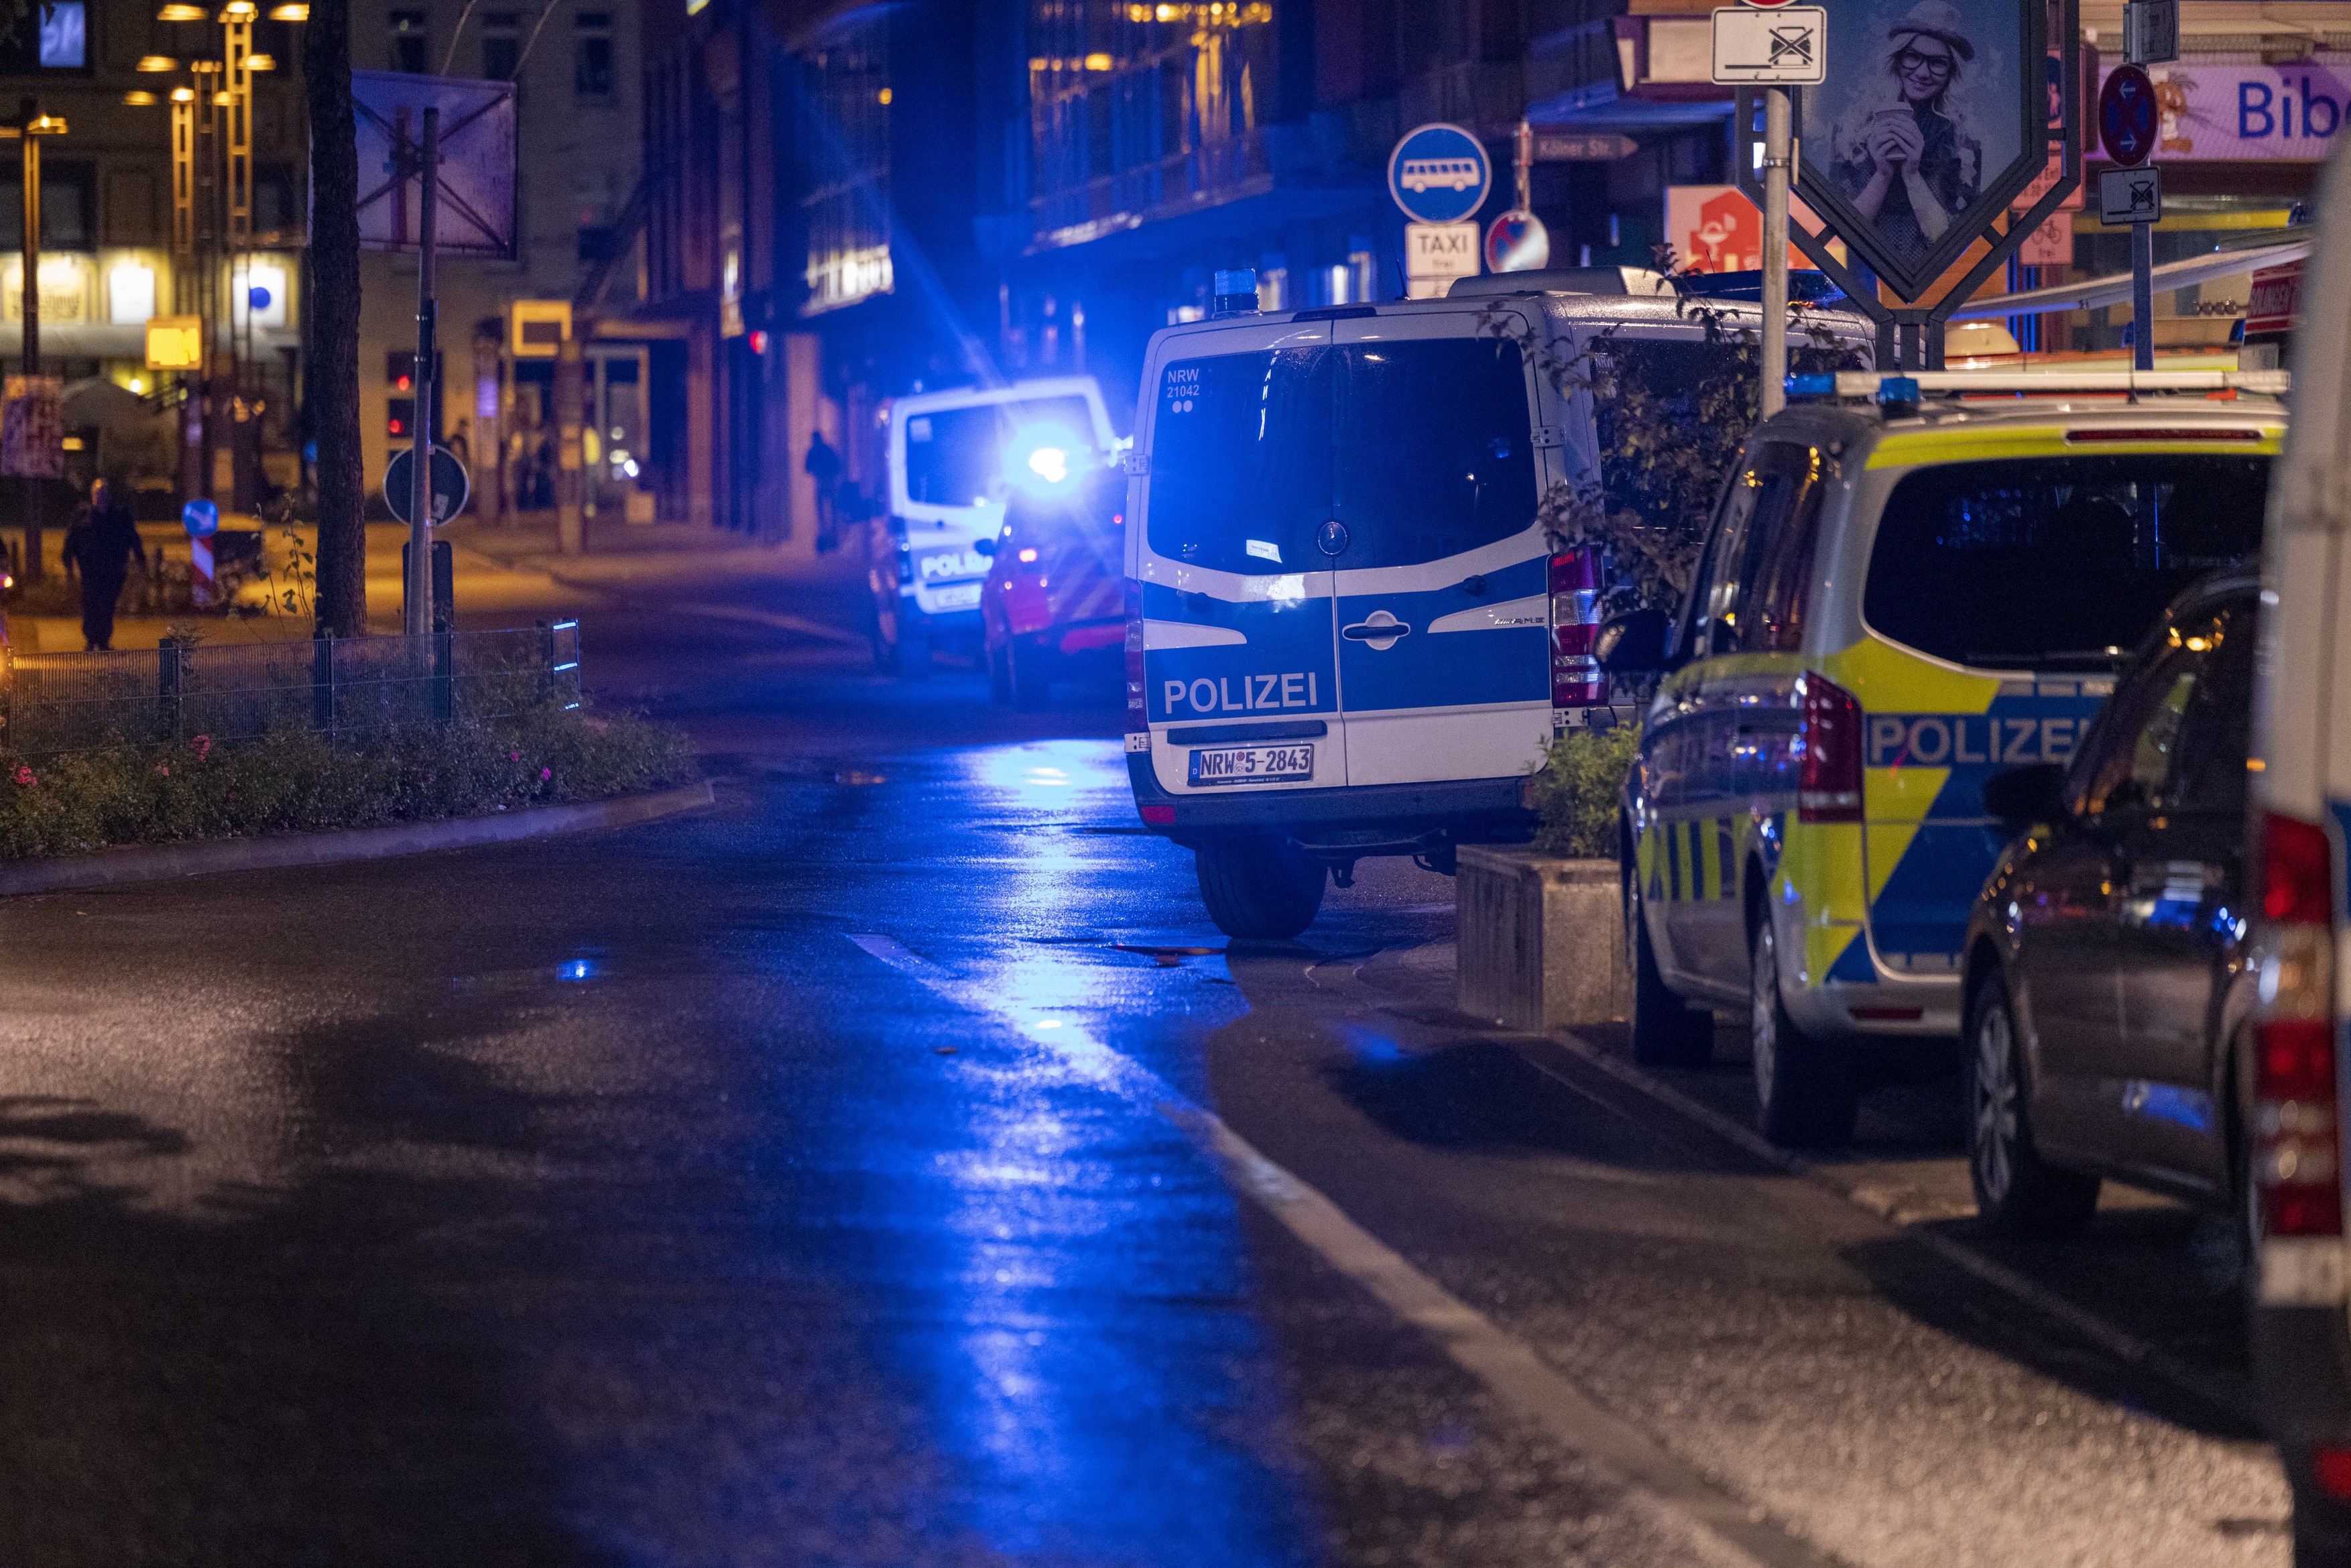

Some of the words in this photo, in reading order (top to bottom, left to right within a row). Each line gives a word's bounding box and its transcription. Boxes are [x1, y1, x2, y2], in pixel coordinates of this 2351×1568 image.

[1417, 234, 1468, 255] TAXI
[1168, 369, 1200, 383] NRW
[1167, 385, 1200, 398] 21042
[1164, 672, 1318, 715] POLIZEI
[1201, 752, 1235, 776] NRW
[1245, 748, 1310, 774] 5-2843
